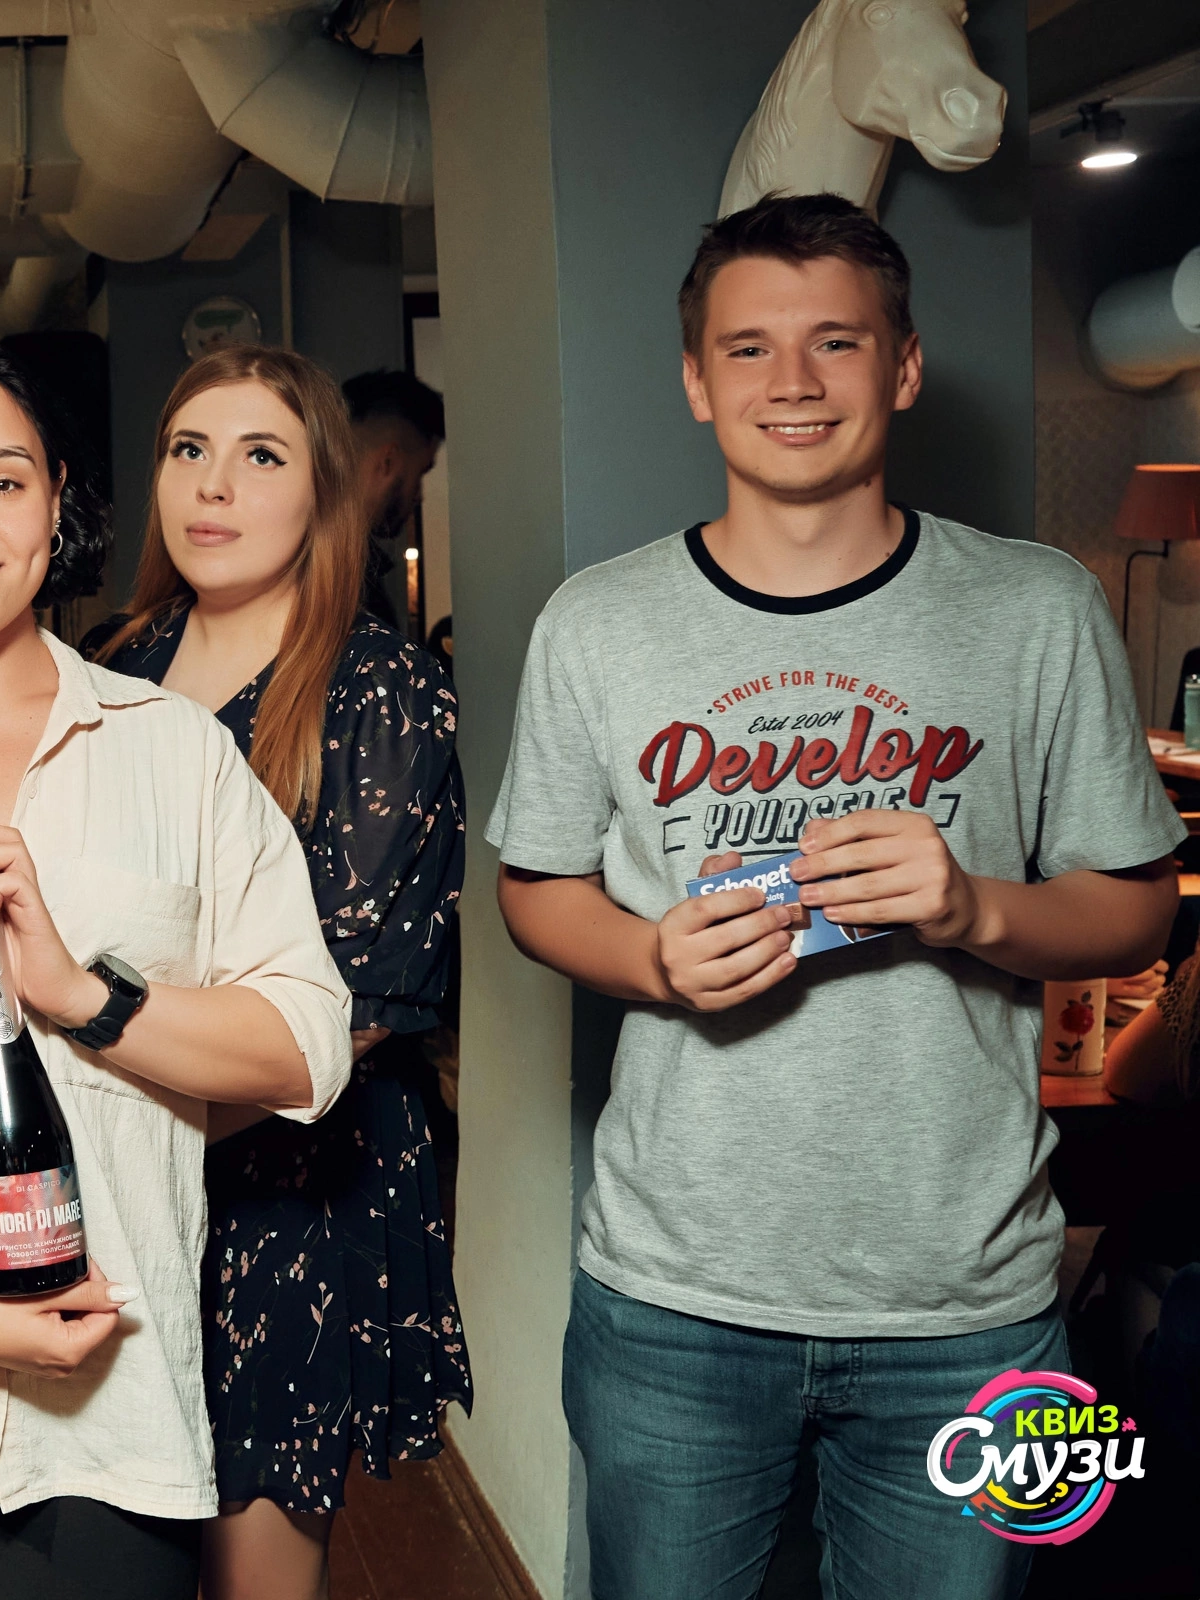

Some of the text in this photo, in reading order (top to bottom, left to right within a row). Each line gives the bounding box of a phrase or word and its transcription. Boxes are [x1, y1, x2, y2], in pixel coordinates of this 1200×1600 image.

[712, 670, 908, 715] STRIVE FOR THE BEST
[748, 710, 844, 734] Estd 2004
[638, 705, 984, 808] Develop
[35, 1208, 51, 1230] DI
[53, 1199, 82, 1227] MARE
[6, 1250, 39, 1258] РОЗОВОЕ
[40, 1240, 79, 1255] ПОЛУСЛАДКОЕ
[34, 1234, 72, 1248] ЖЕМЧУЖНОЕ
